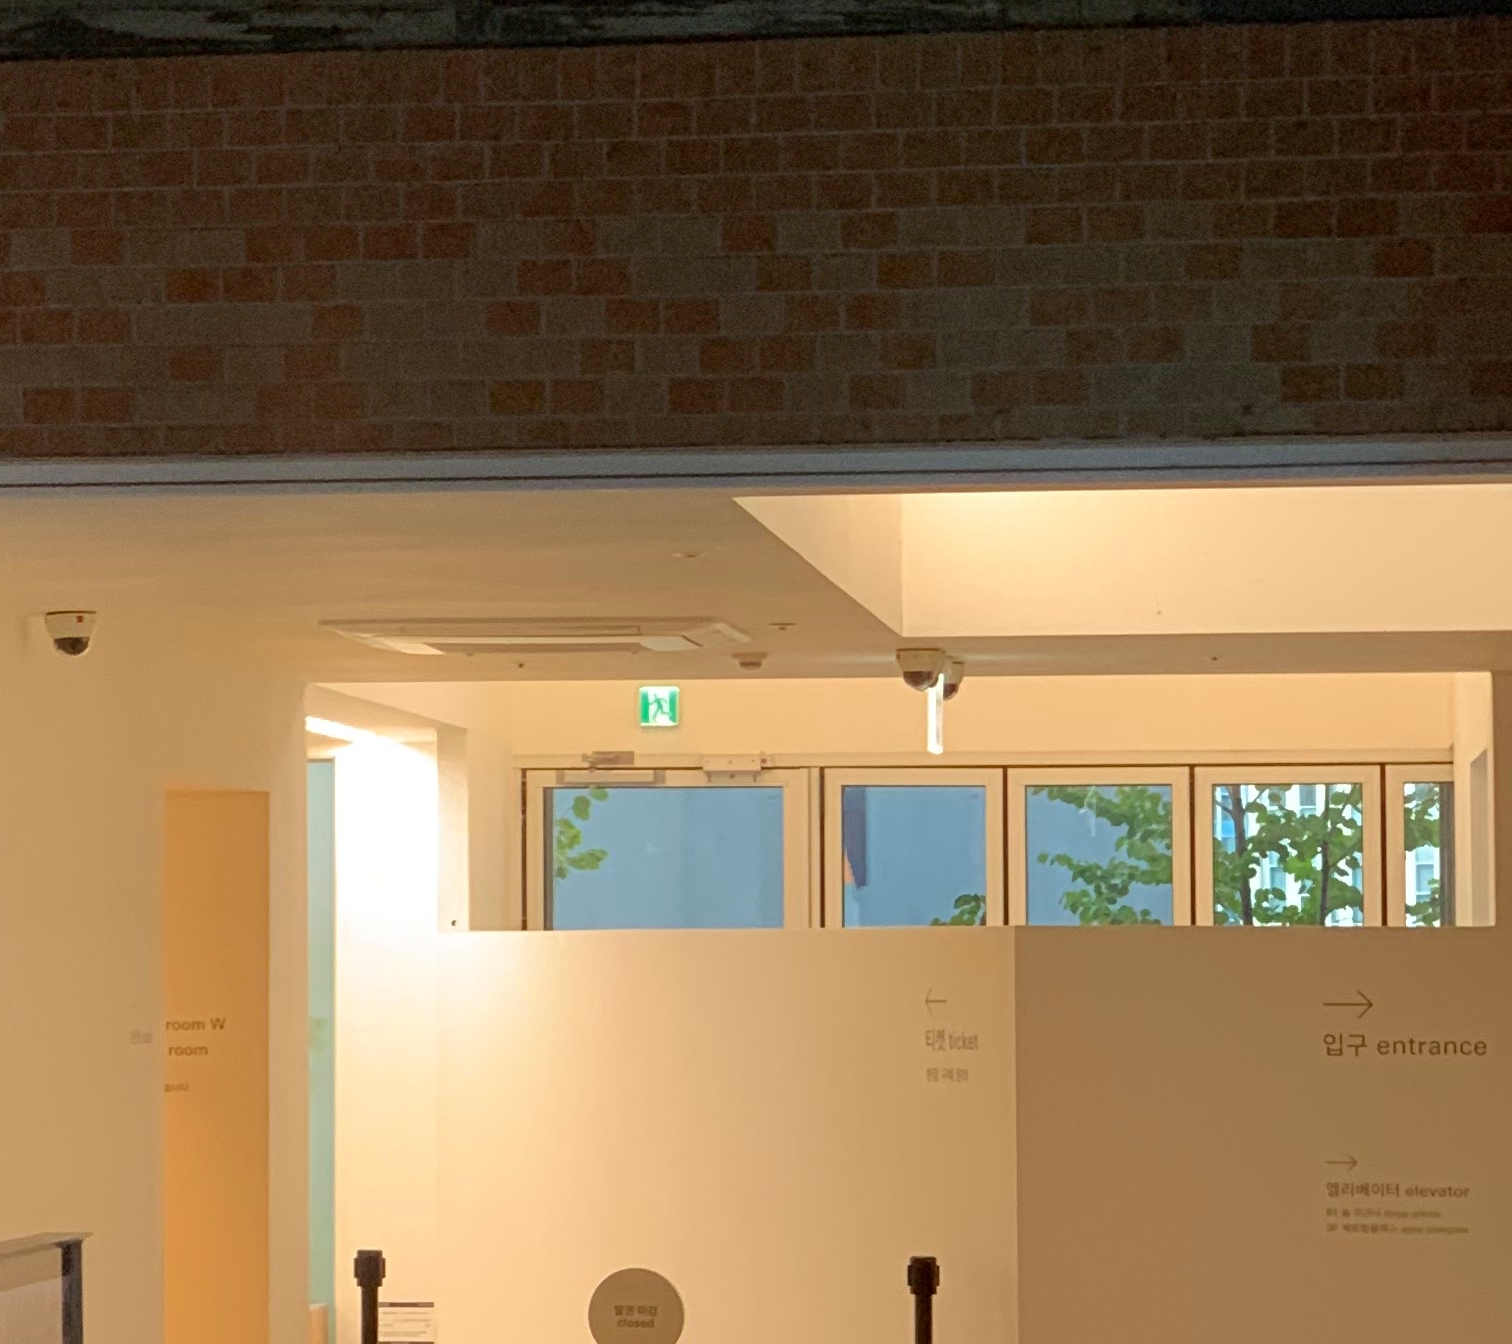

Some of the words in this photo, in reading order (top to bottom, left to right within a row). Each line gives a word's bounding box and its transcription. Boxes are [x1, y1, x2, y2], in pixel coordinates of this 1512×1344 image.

[165, 1020, 206, 1031] room
[948, 1030, 979, 1050] ticket
[1323, 1032, 1368, 1057] 입구
[1376, 1037, 1487, 1056] entrance
[1405, 1185, 1470, 1197] elevator
